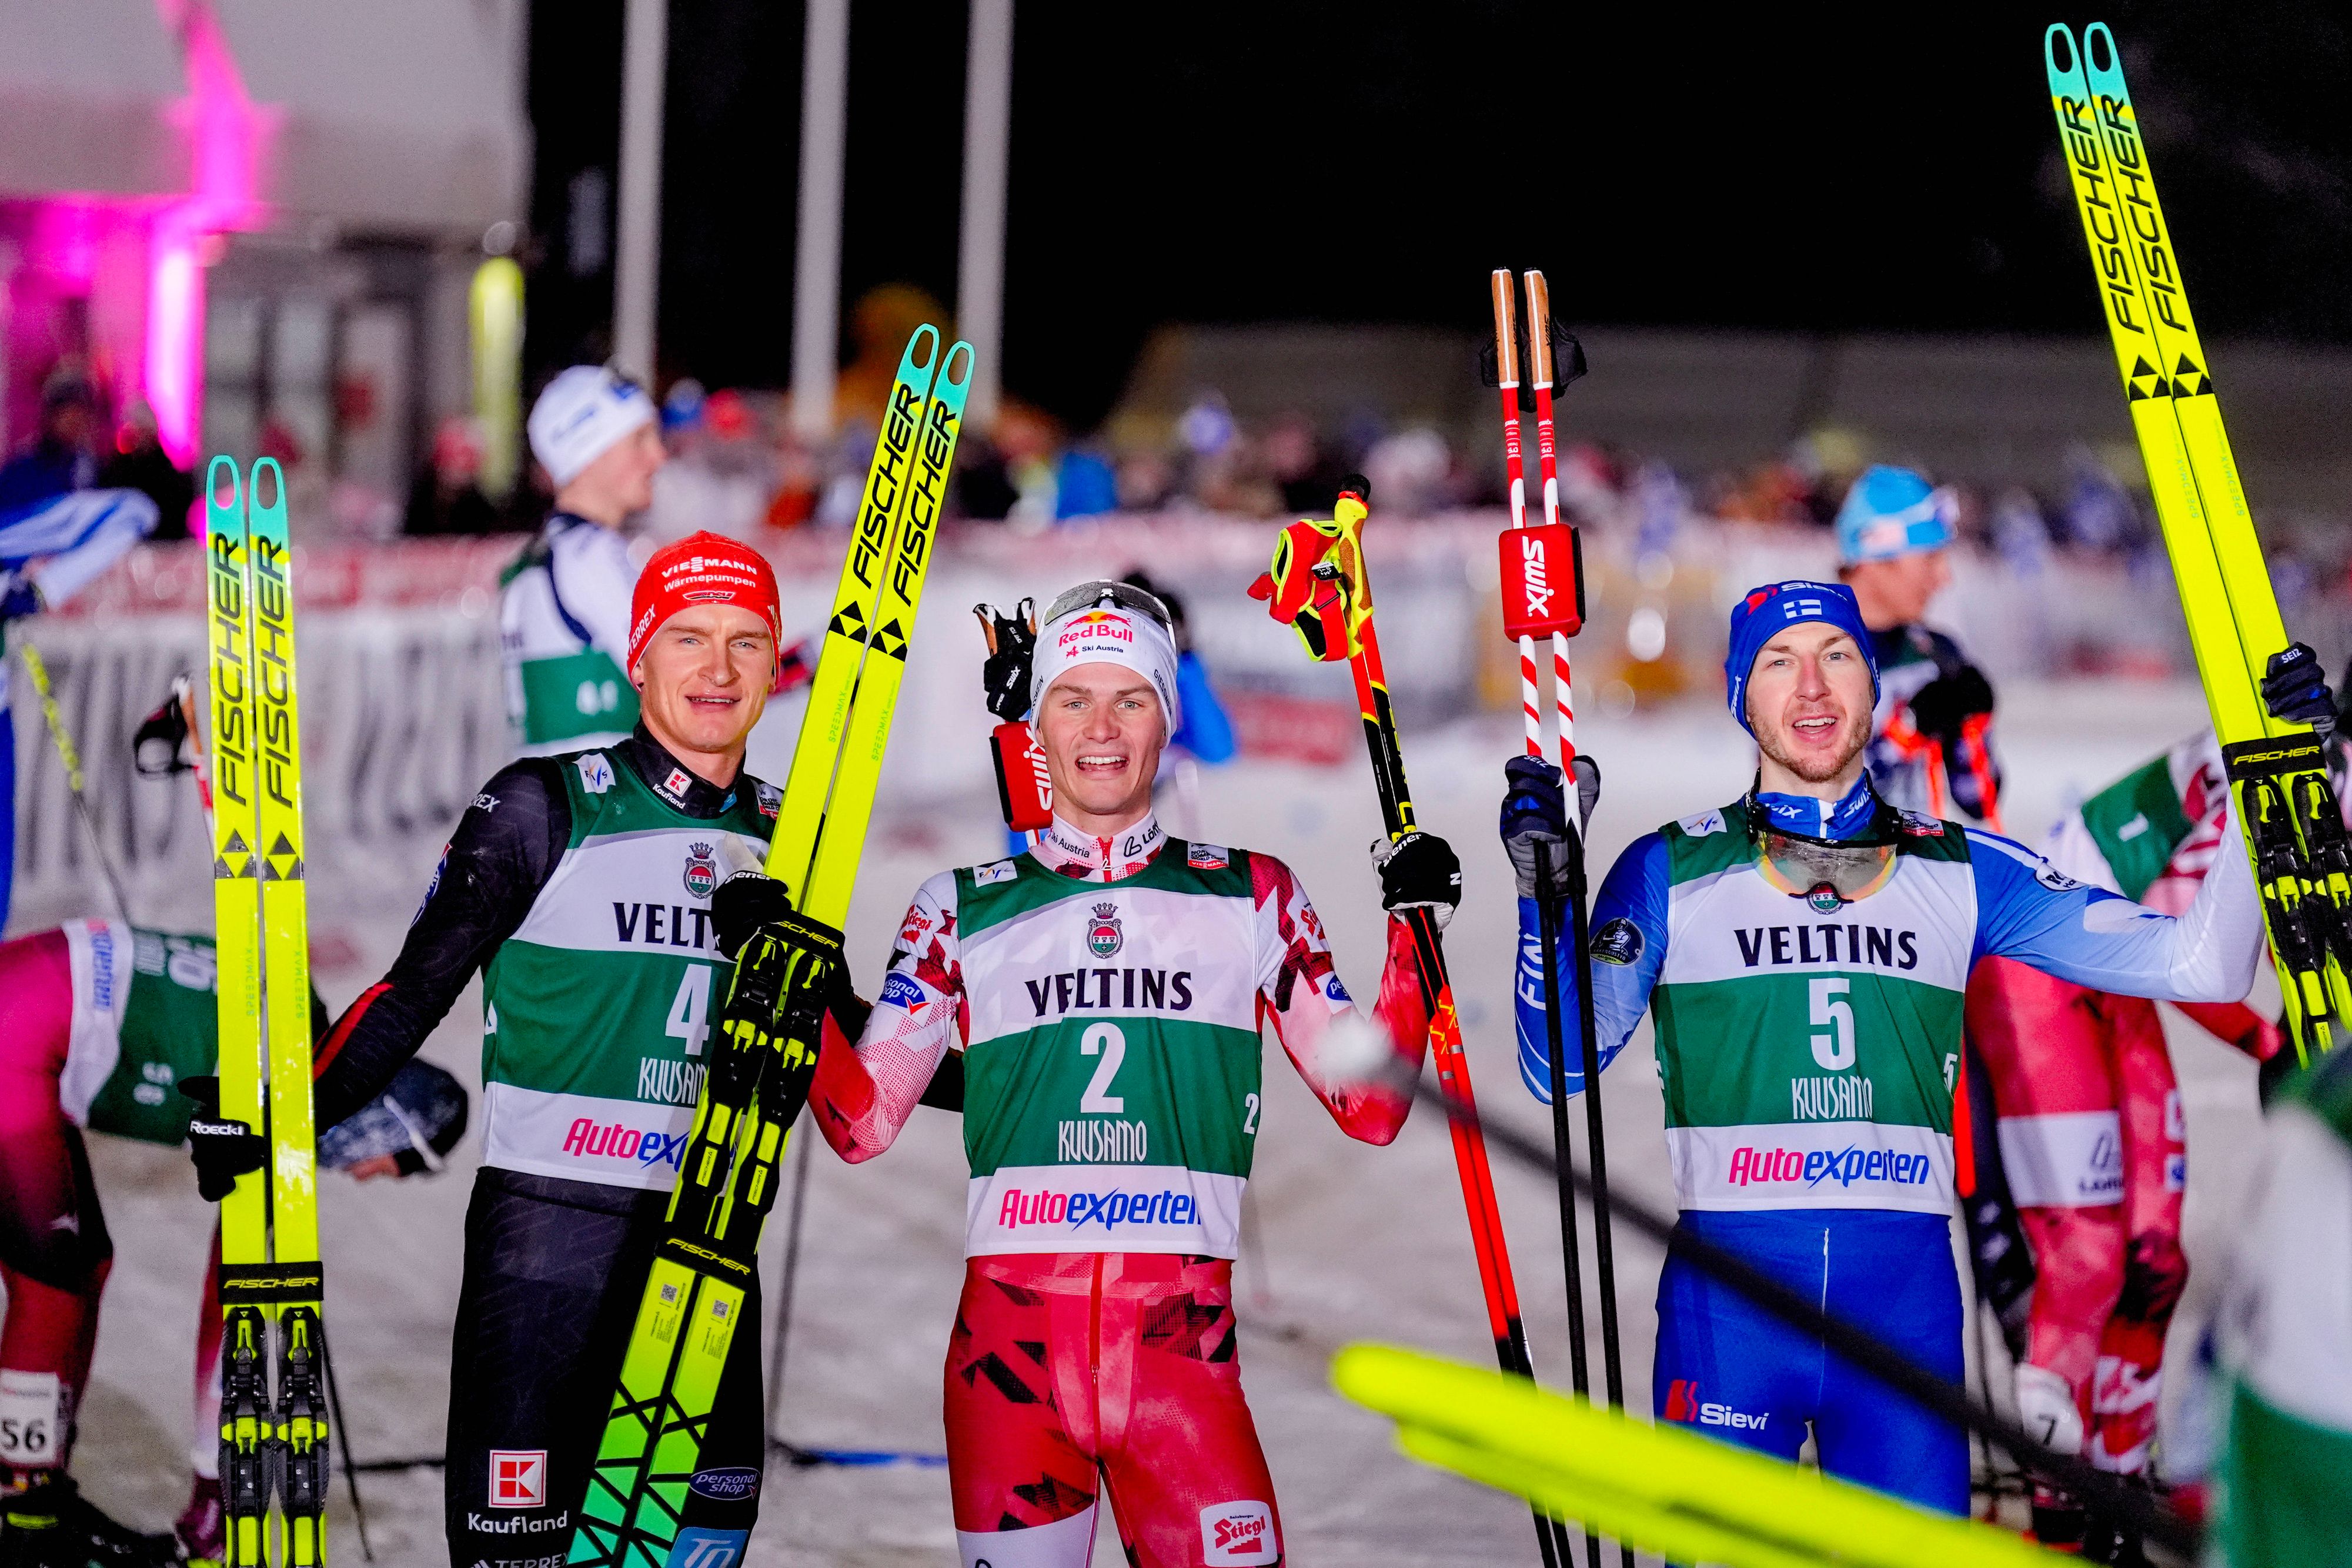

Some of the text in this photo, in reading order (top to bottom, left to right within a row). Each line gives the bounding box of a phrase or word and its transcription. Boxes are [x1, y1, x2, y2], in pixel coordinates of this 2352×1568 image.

[2061, 95, 2146, 335] FISCHER
[2101, 93, 2188, 333] FISCHER
[853, 383, 921, 589] FISCHER
[893, 400, 957, 607] FISCHER
[662, 556, 757, 578] VIESSMANN
[664, 574, 756, 592] Wärmepumpen
[629, 603, 656, 654] TERREX
[1058, 624, 1133, 647] Red Bull
[1095, 645, 1124, 653] Austria
[214, 531, 246, 807] FISCHER
[258, 534, 293, 809] FISCHER
[2281, 648, 2302, 663] SEIZ
[828, 690, 847, 743] SPEEDMAX
[871, 709, 889, 761] SPEEDMAX
[2233, 745, 2320, 766] FISCHER
[652, 783, 686, 810] Kaufland
[1058, 838, 1090, 858] Austria
[1383, 834, 1422, 868] ziener
[1733, 923, 1919, 970] VELTINS
[664, 963, 712, 1056] 4
[1024, 968, 1193, 1018] VELTINS
[1808, 977, 1856, 1071] 5
[637, 1057, 707, 1104] KUUSAM
[1080, 1022, 1126, 1114] 2
[1243, 1092, 1260, 1135] 2
[1791, 1077, 1874, 1120] KUUSAMO
[1058, 1120, 1148, 1162] KUUSAMO
[1728, 1143, 1930, 1190] Autoexperten
[666, 1238, 751, 1276] FISCHER
[223, 1276, 319, 1289] FISCHER
[1, 1419, 45, 1453] 56
[1699, 1403, 1769, 1430] Sievi
[695, 1472, 757, 1486] personal
[709, 1480, 746, 1495] shop
[467, 1510, 568, 1534] Kaufland
[1214, 1515, 1266, 1549] Stiegl
